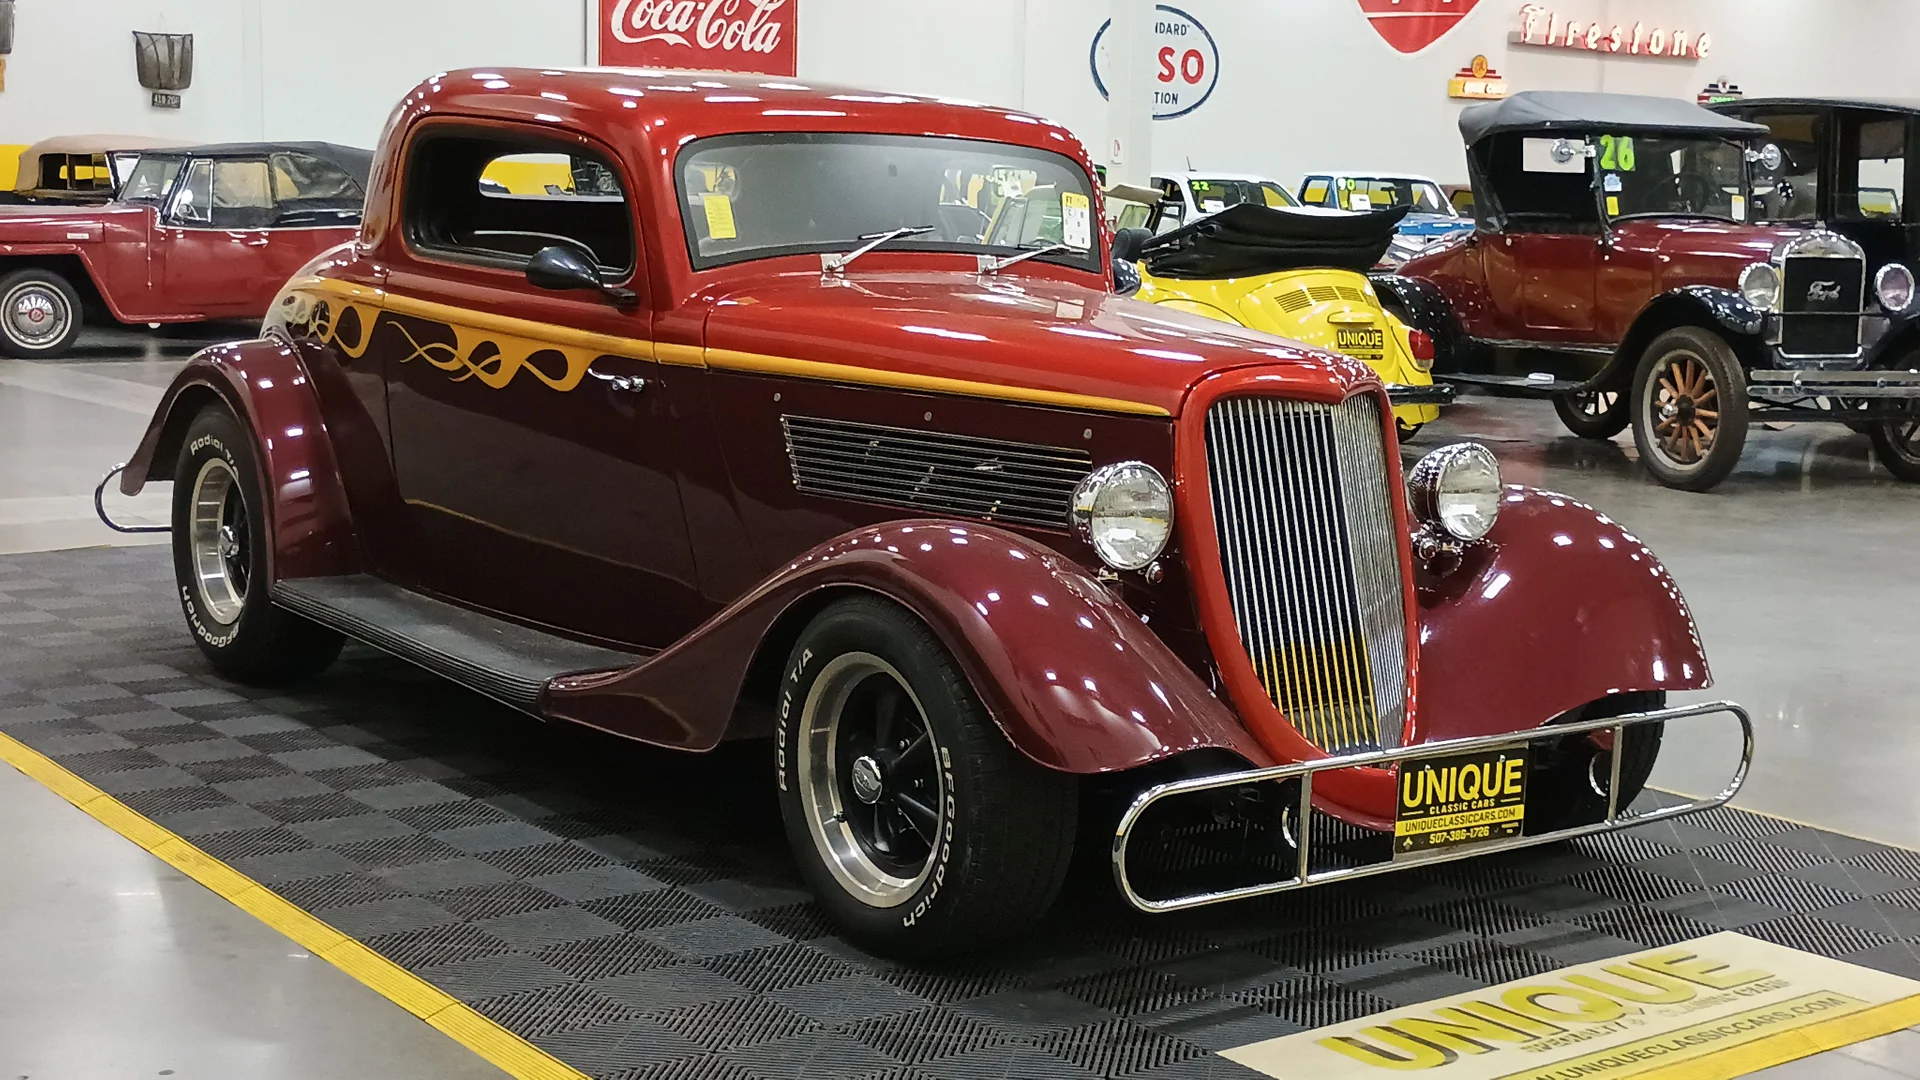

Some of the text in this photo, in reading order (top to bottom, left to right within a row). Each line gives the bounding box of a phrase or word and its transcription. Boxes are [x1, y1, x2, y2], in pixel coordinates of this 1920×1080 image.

[1155, 22, 1187, 36] DARD
[1518, 4, 1712, 59] Firestone
[1157, 46, 1205, 85] SO
[1153, 91, 1179, 105] TION
[1600, 134, 1636, 171] 26
[1191, 180, 1210, 191] 22
[1807, 280, 1841, 302] Ford
[1338, 330, 1383, 346] UNIQUE
[190, 433, 223, 456] Radial
[181, 585, 240, 648] BFGoodrich
[777, 648, 814, 792] Radial T/A
[1402, 759, 1524, 808] UNIQUE
[1429, 798, 1495, 815] CLASSIC CARS
[1405, 808, 1516, 833] UNIQUECLASSICCARS.COM
[902, 746, 956, 928] BFGoodrich
[1429, 826, 1490, 845] 507-386-1726
[1318, 947, 1777, 1071] UNIQUE
